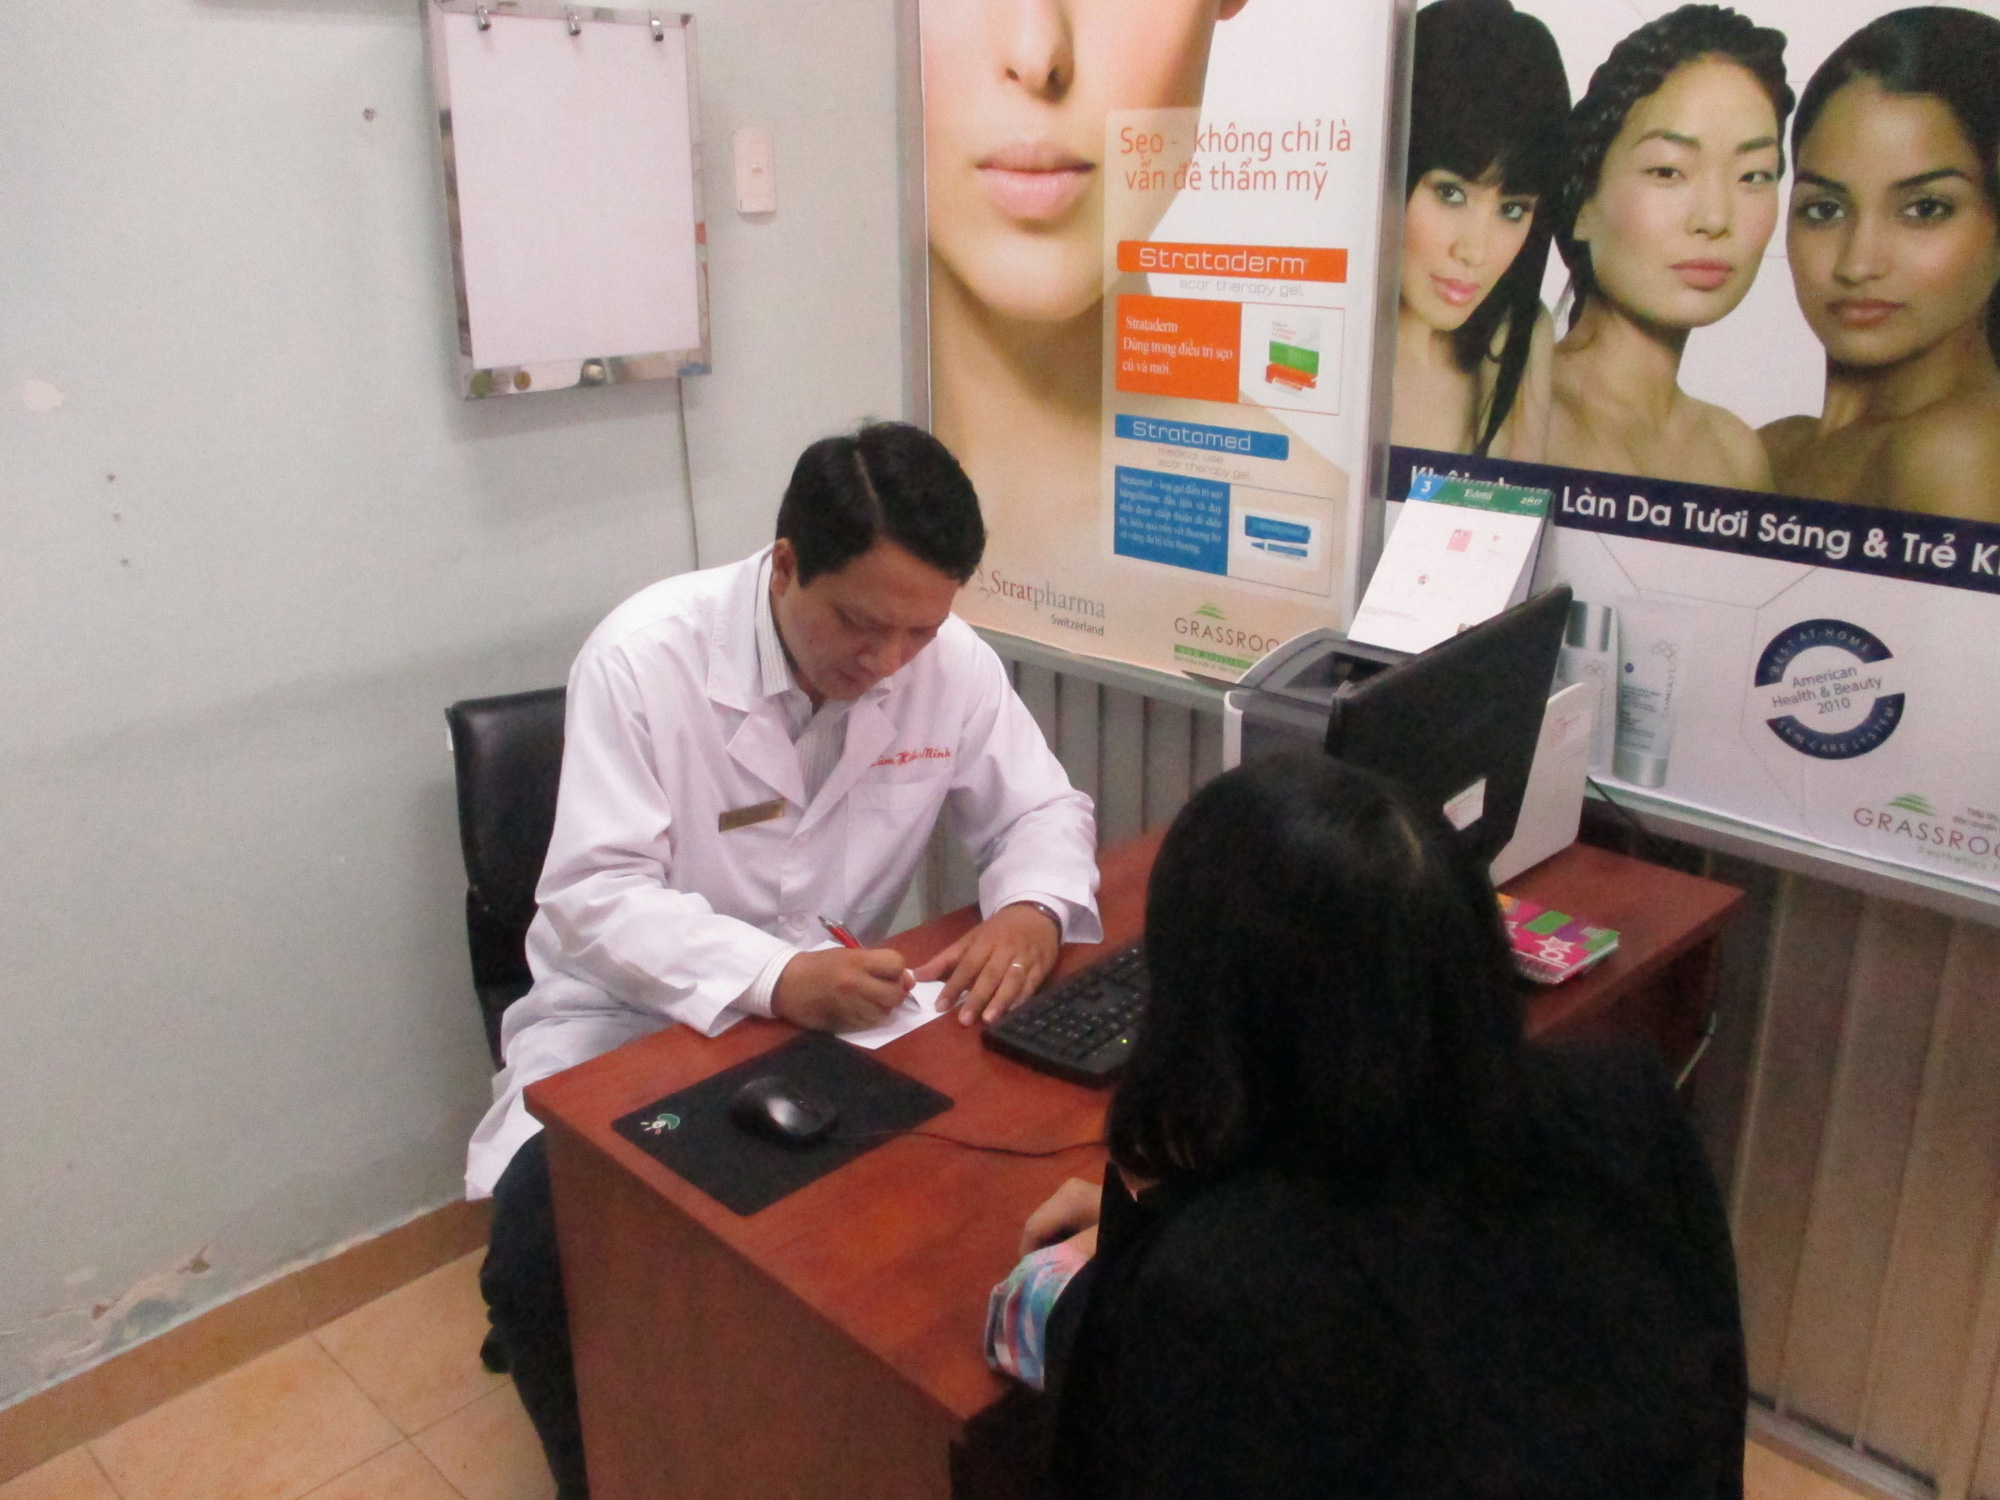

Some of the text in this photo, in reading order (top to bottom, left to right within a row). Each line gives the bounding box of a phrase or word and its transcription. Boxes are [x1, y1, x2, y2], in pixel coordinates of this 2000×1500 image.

[1192, 122, 1273, 162] không
[1281, 118, 1321, 152] chỉ
[1328, 117, 1352, 152] là
[1208, 157, 1277, 191] thẩm
[1286, 161, 1329, 200] mỹ
[1139, 247, 1304, 275] Strataderm
[1179, 279, 1212, 291] scar
[1216, 280, 1275, 296] therapy
[1125, 316, 1178, 333] Strataderm
[1151, 341, 1177, 358] trong
[1132, 420, 1251, 451] Stratamed
[1562, 486, 1616, 519] Làn
[1627, 495, 1671, 527] Da
[1683, 502, 1748, 538] Tươi
[1758, 513, 1850, 560] Sáng
[1863, 528, 1888, 559] &
[1902, 532, 1957, 569] Trẻ
[990, 569, 1106, 618] Stratpharma
[1051, 613, 1105, 637] Switzerland
[1792, 666, 1858, 689] American
[1771, 676, 1882, 708] Health & Beauty
[1816, 696, 1852, 714] 2010
[919, 747, 951, 760] Minh
[1853, 807, 2000, 859] GRASSRO
